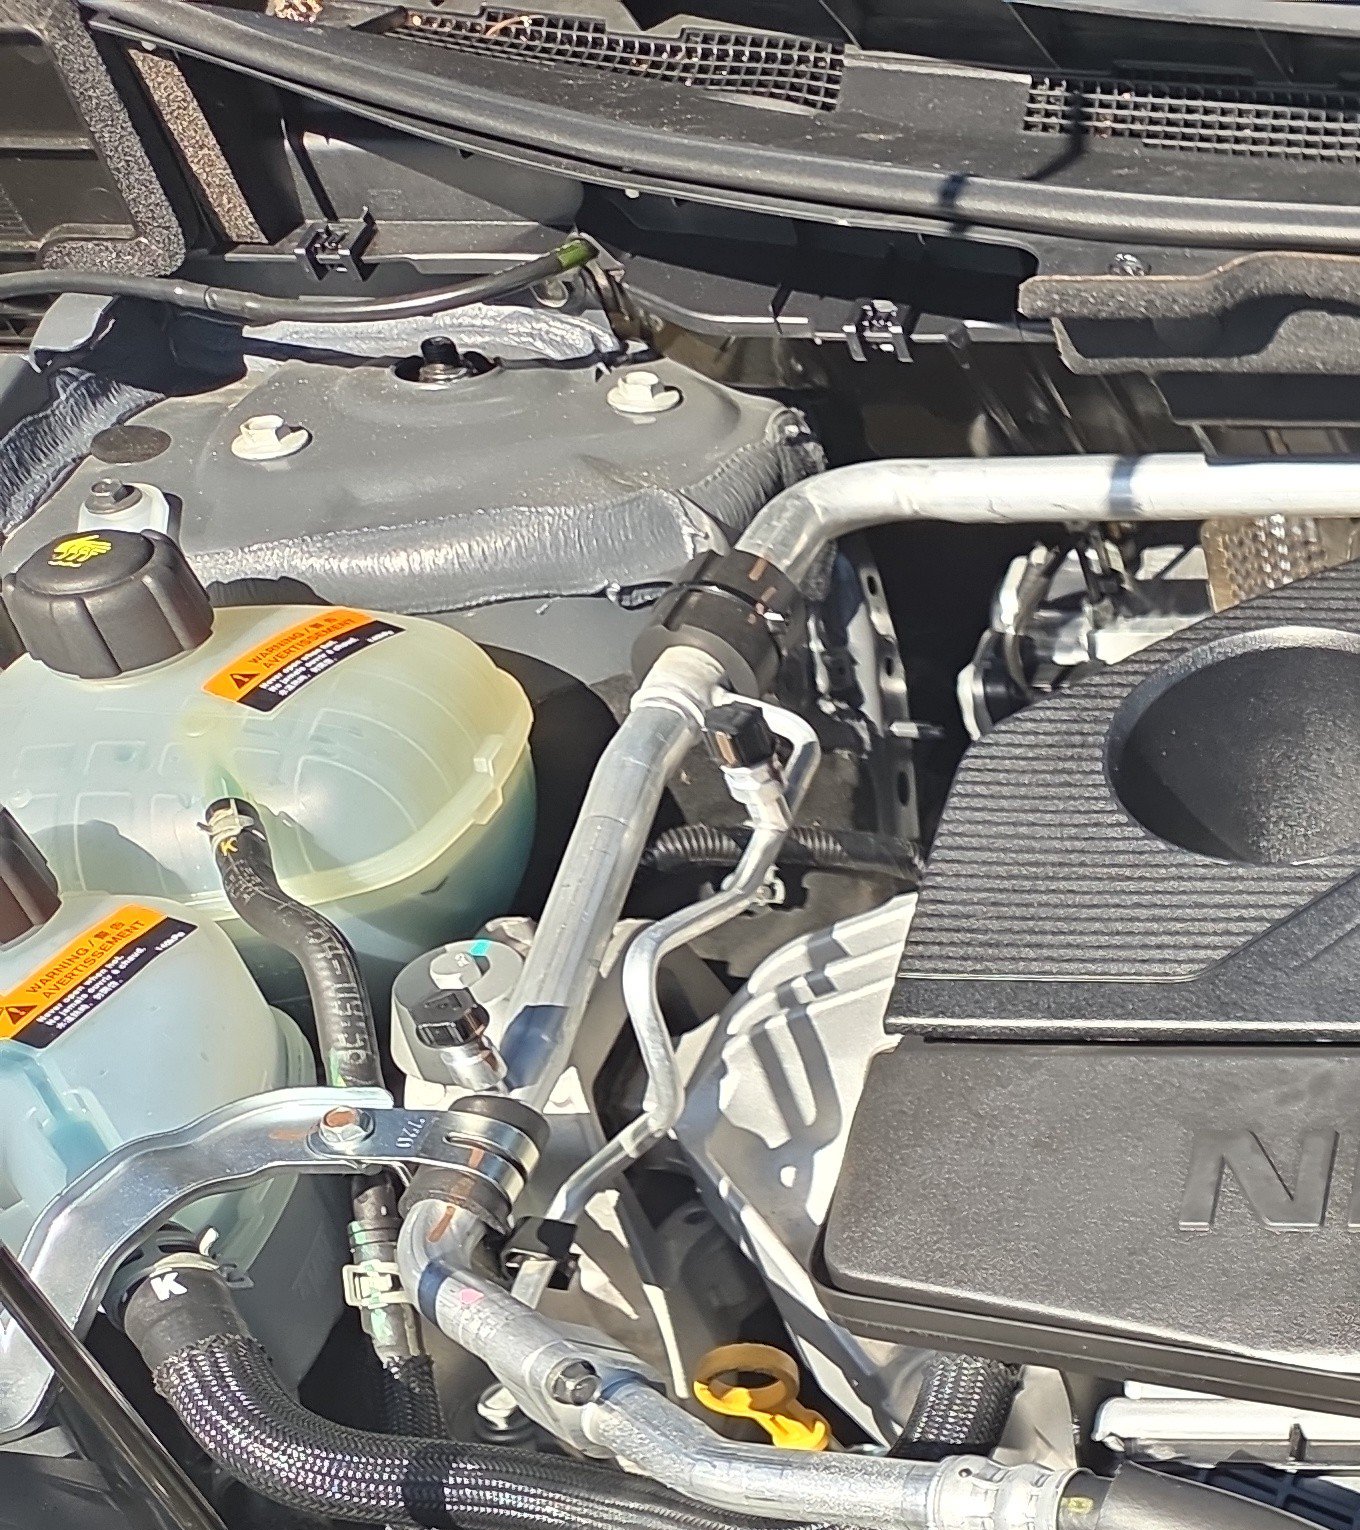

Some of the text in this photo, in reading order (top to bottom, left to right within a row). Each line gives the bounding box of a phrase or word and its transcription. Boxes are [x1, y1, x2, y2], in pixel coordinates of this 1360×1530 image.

[249, 629, 306, 665] WARNING
[262, 618, 355, 670] AVERTISSEMENT
[26, 946, 91, 995] WARNING
[42, 919, 146, 1000] AVERTISSEMENT
[150, 1271, 188, 1301] K
